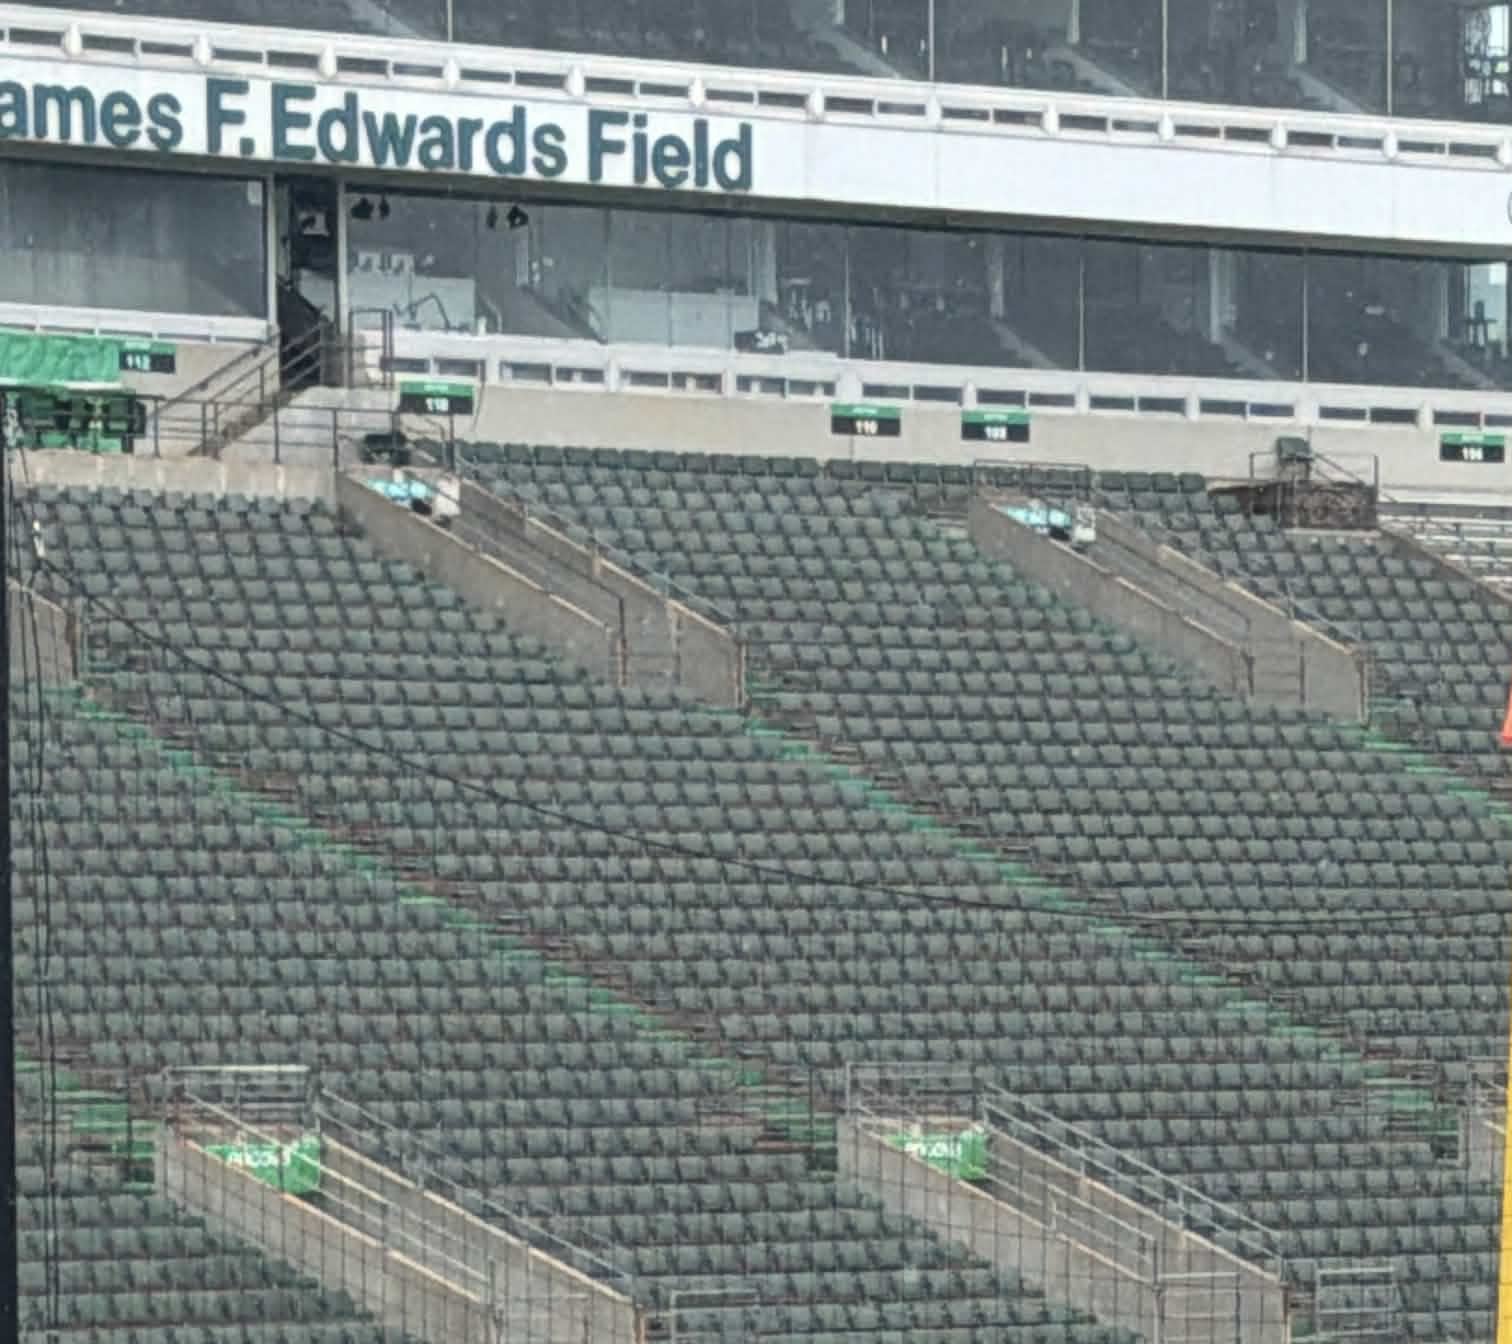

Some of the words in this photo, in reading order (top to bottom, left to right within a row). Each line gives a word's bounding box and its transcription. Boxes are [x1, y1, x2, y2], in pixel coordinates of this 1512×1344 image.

[0, 80, 184, 151] ames
[206, 78, 255, 155] F.
[271, 83, 568, 178] Edwards
[588, 108, 753, 192] Field
